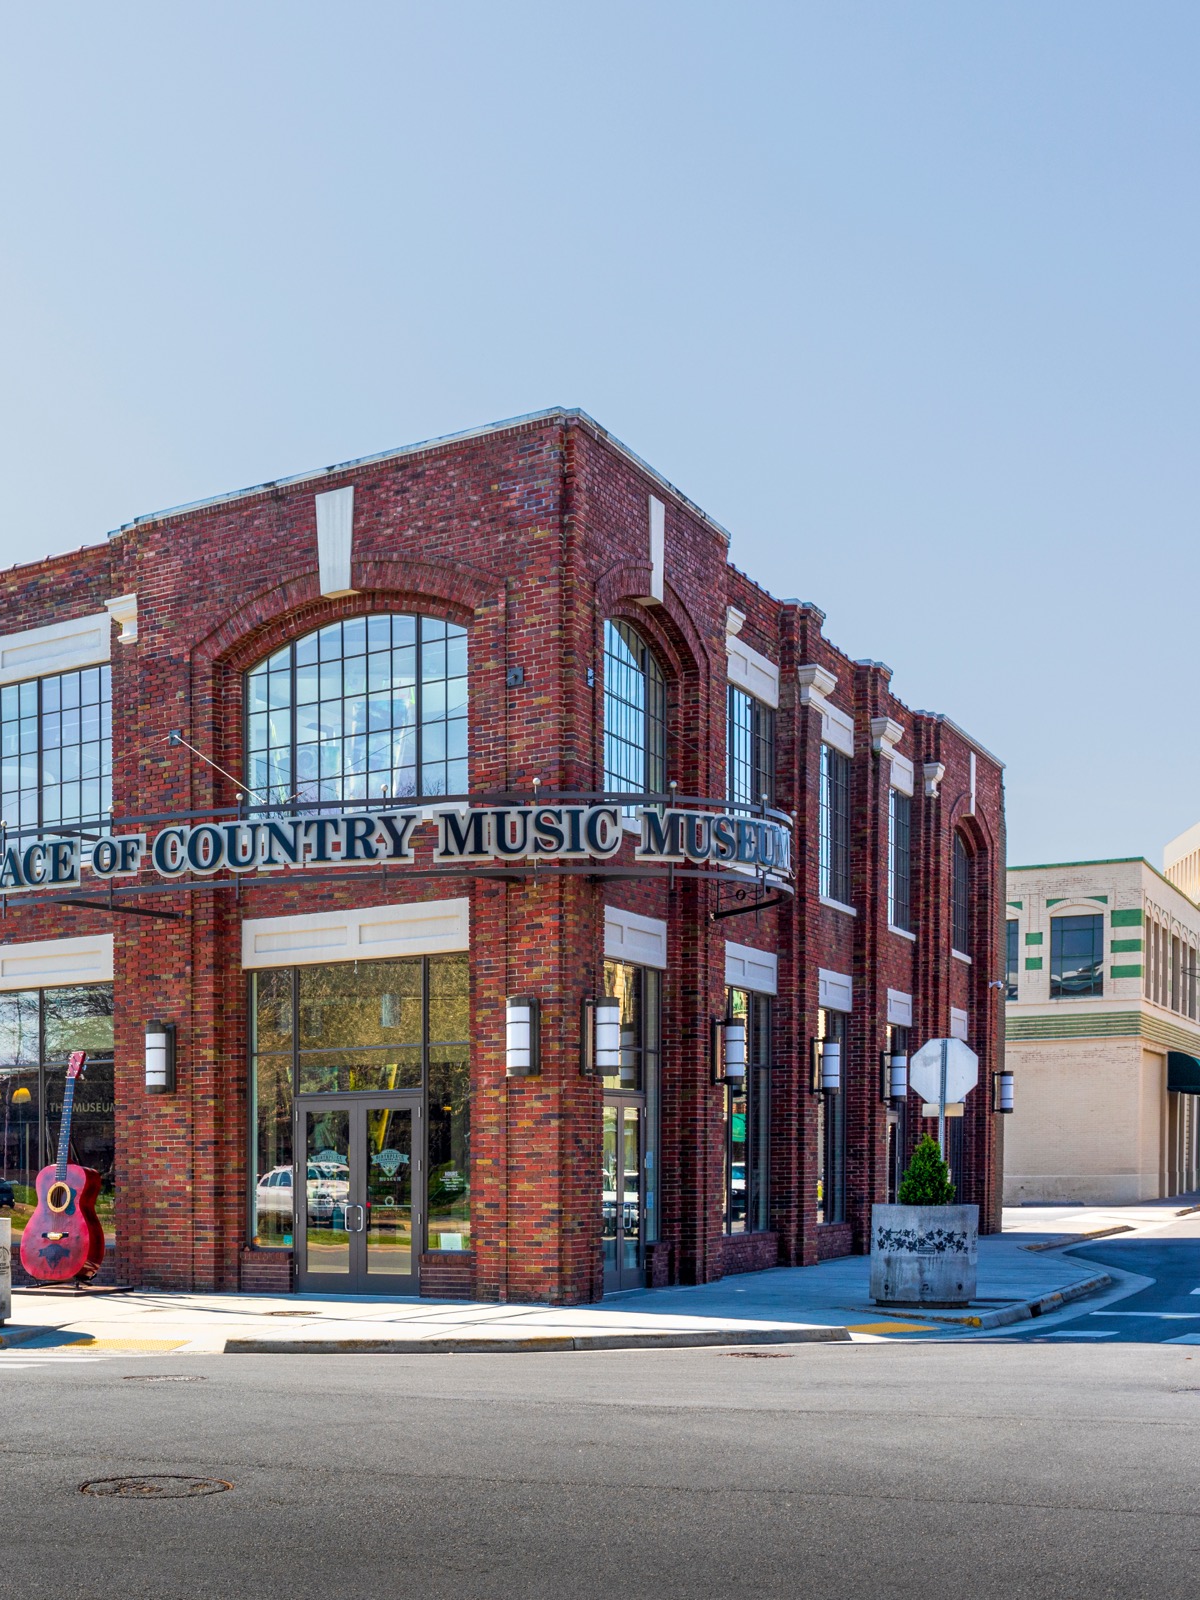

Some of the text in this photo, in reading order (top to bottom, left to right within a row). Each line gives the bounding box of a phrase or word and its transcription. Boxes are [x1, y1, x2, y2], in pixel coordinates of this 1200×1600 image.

[99, 838, 140, 873] OF
[155, 814, 416, 873] COUNTRY
[440, 808, 620, 856] MUSIC
[642, 811, 791, 871] MUSEUM
